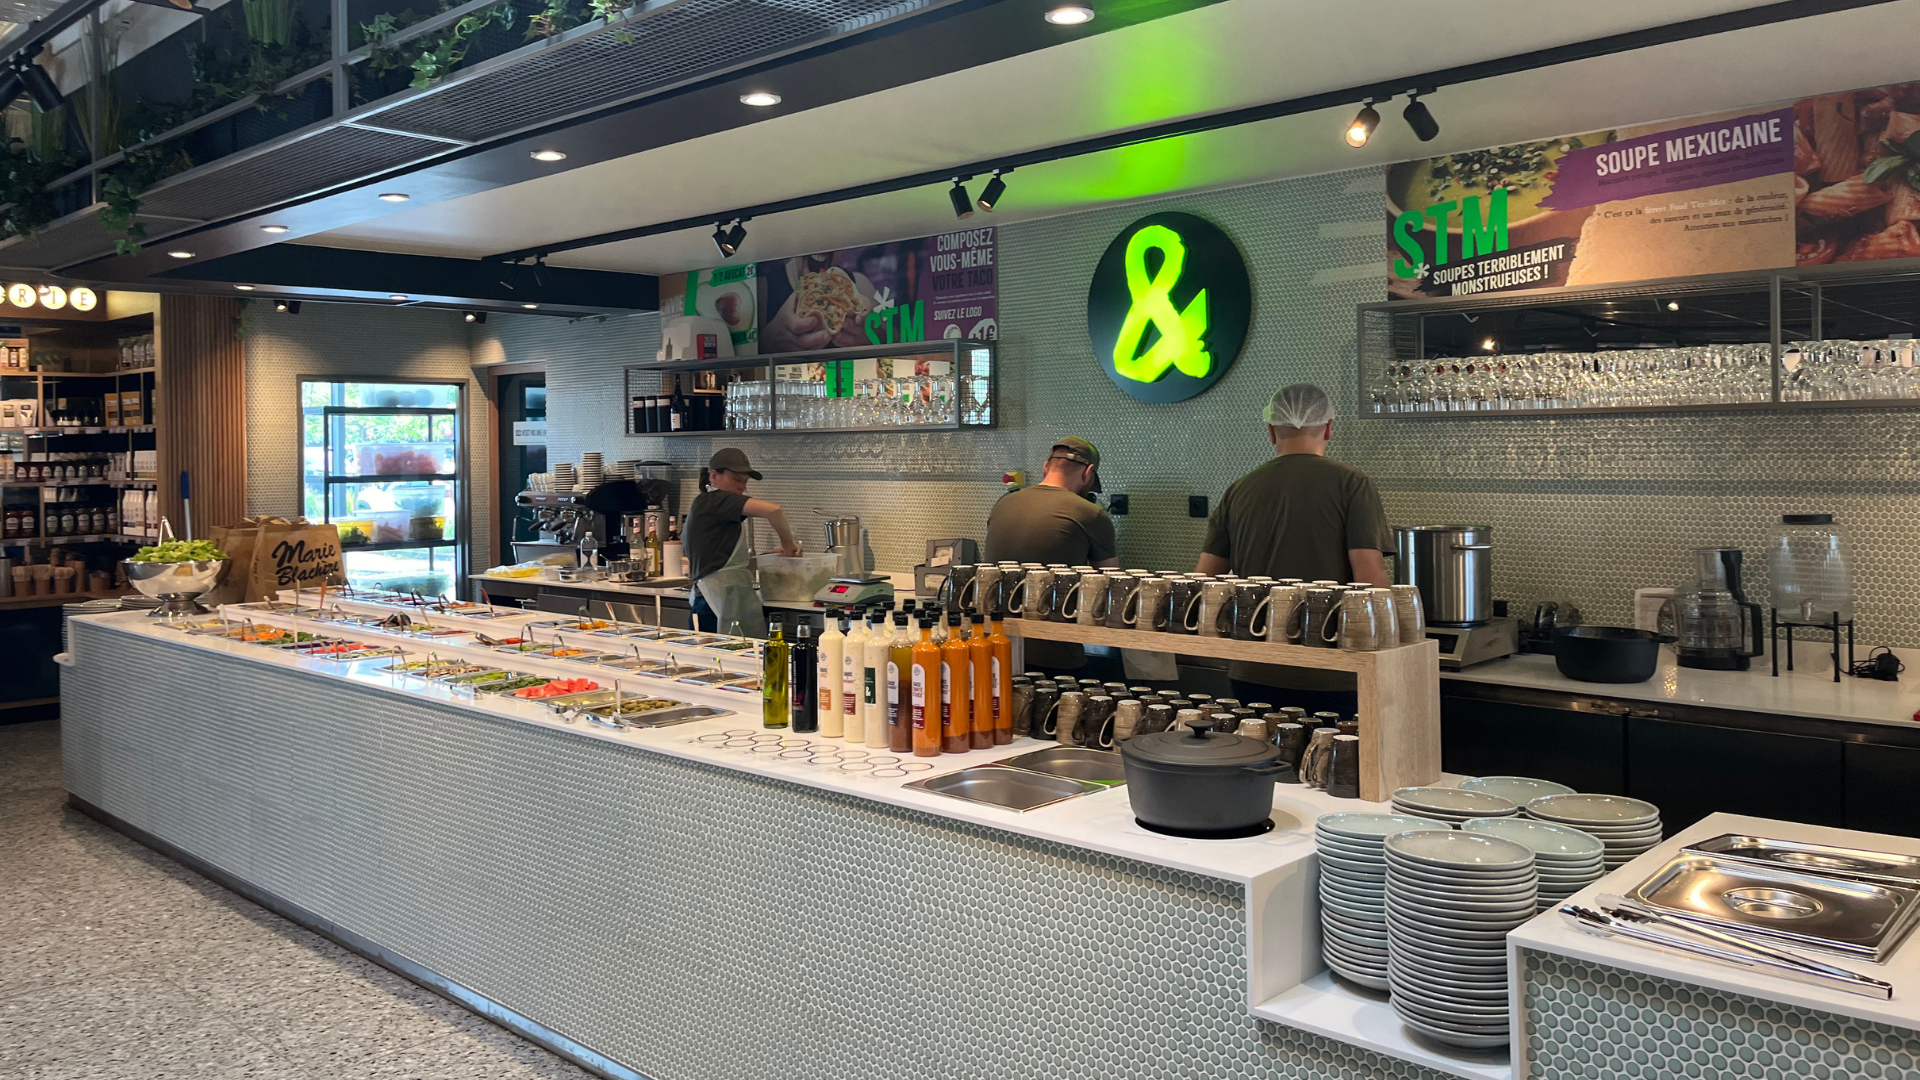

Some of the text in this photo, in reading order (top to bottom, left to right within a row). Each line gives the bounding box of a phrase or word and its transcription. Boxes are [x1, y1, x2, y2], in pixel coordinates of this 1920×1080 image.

[1596, 118, 1782, 177] SOUPE MEXICAINE
[1670, 201, 1688, 211] Food
[1735, 195, 1744, 204] de
[1746, 194, 1754, 202] la
[937, 228, 993, 252] COMPOSEZ
[1394, 187, 1509, 278] STM
[930, 247, 993, 272] VOUS-MÊME
[1433, 244, 1565, 285] SOUPES TERRIBLEMENT
[932, 268, 993, 291] VOTRE TACO
[1452, 264, 1549, 296] MONSTRUEUSES !
[865, 299, 925, 345] STM
[933, 306, 983, 321] SUIVEZ LE LOGO
[271, 540, 335, 568] Marie
[275, 560, 339, 586] Blachère
